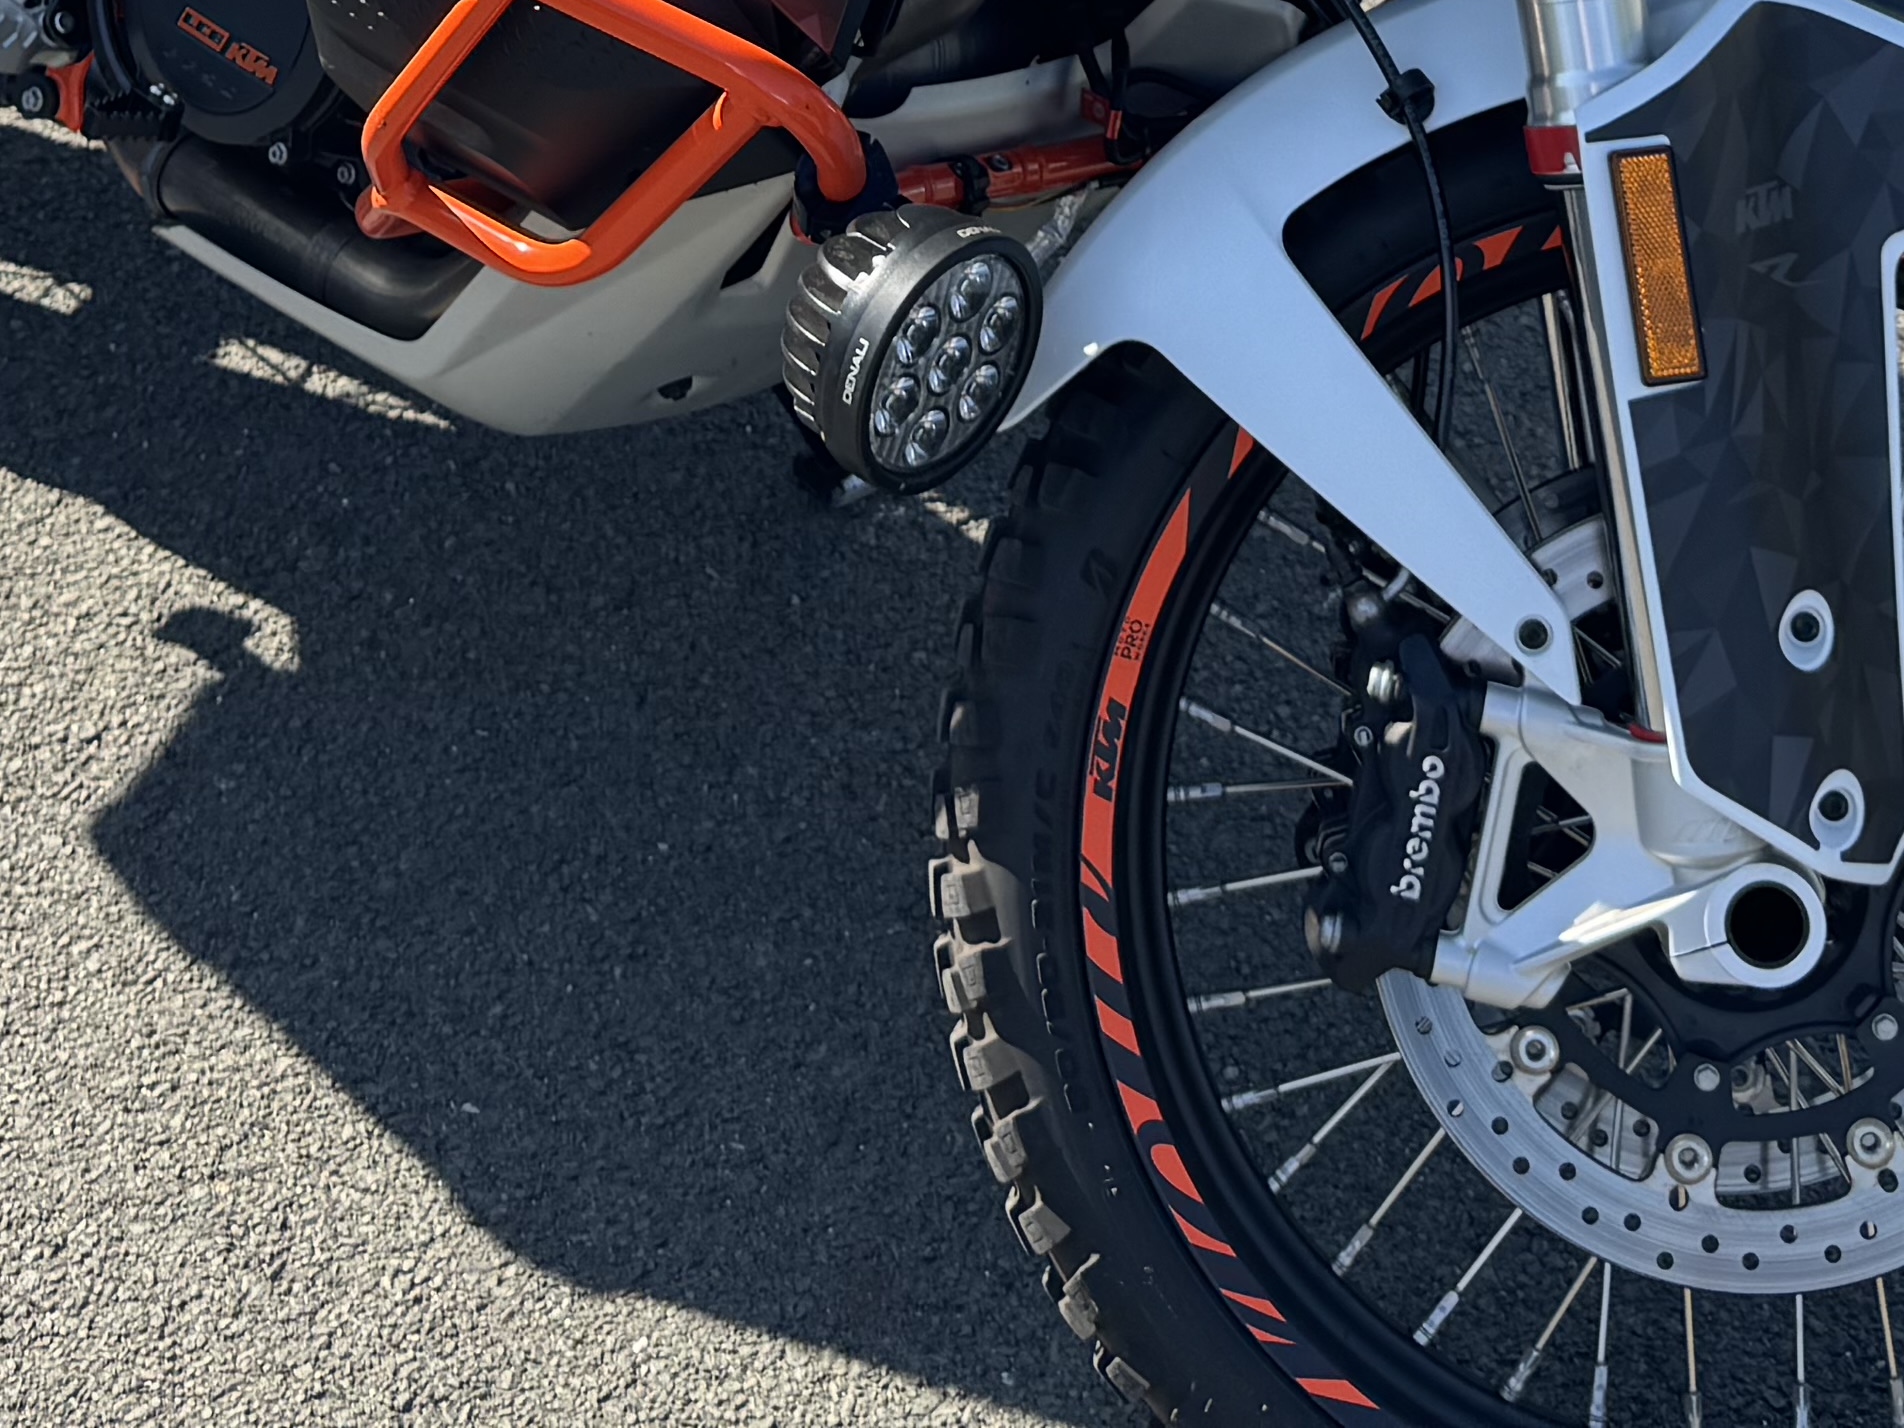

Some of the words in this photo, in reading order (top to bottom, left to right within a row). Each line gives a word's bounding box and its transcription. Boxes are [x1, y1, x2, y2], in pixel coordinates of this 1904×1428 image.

[225, 41, 279, 86] KTM
[1736, 180, 1794, 235] KTM
[841, 337, 871, 406] DENALI
[1120, 619, 1143, 661] PRO
[1089, 696, 1127, 803] KTM
[1389, 755, 1445, 901] brembo
